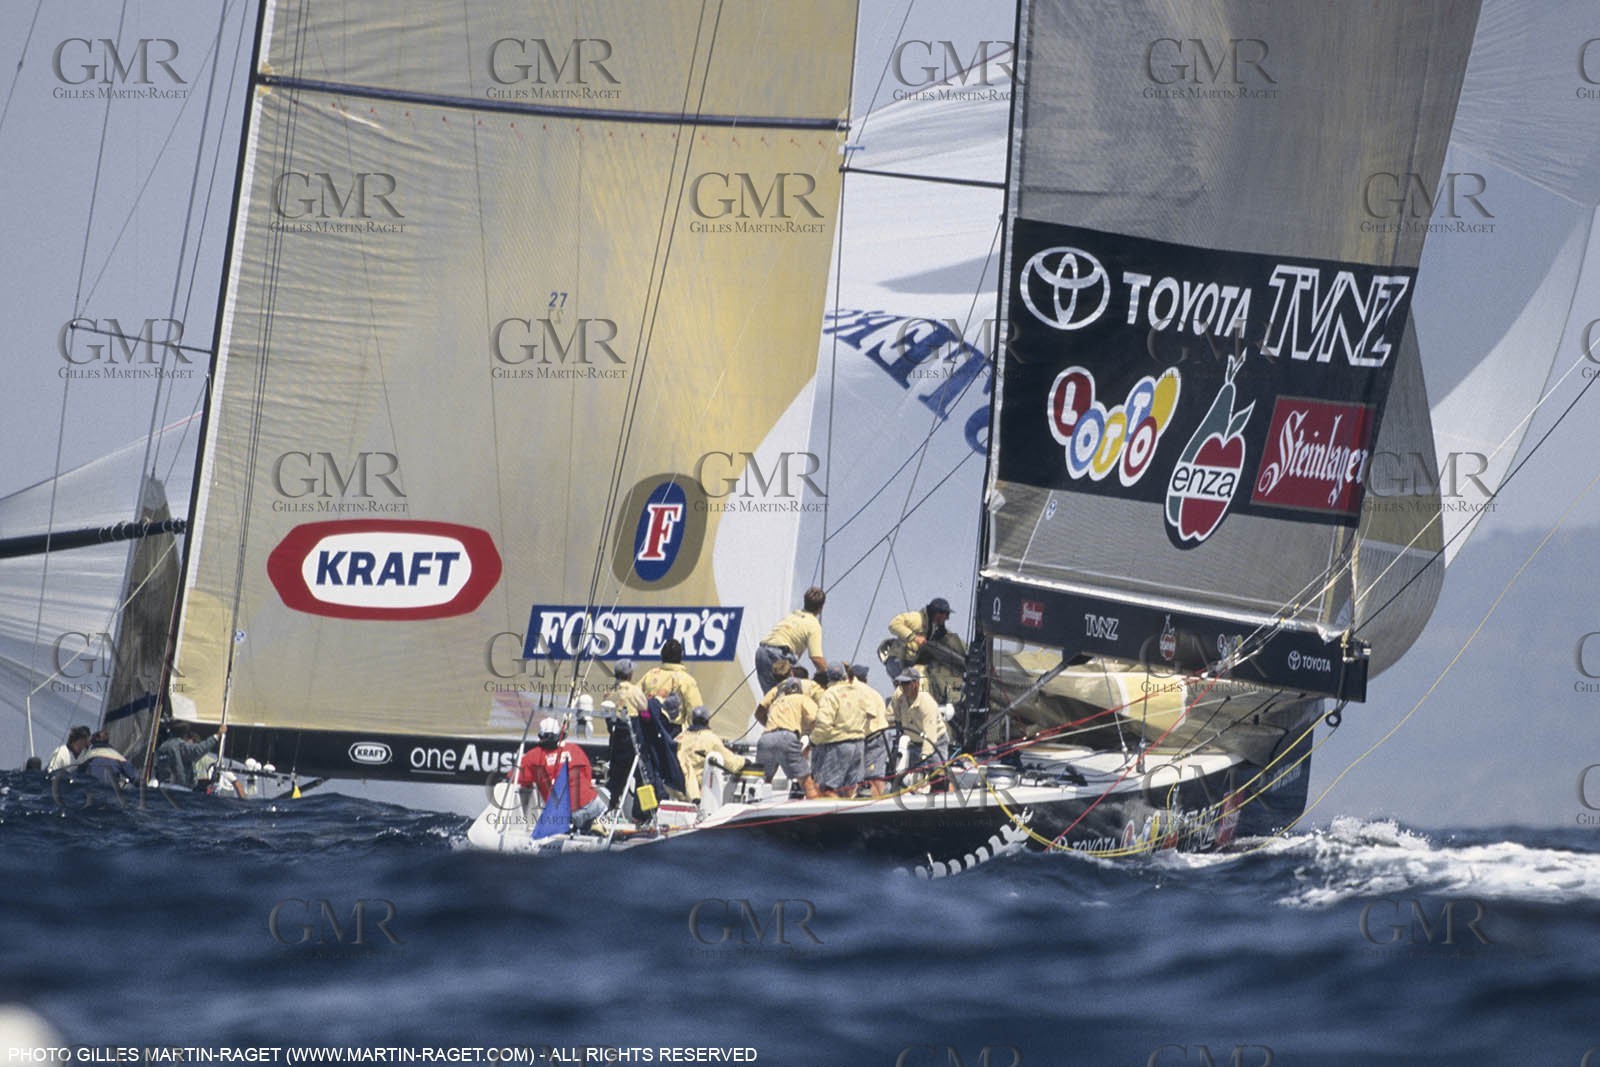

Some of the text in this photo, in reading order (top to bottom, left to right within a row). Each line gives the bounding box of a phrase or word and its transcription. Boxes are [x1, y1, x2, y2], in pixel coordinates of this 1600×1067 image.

[548, 291, 568, 308] 27
[1122, 271, 1252, 339] TOYOTA
[1260, 264, 1411, 368] TVNZ
[1056, 375, 1162, 477] LOTTO
[1257, 409, 1369, 507] Steinlager
[1171, 463, 1237, 499] enza
[638, 504, 684, 561] F
[315, 550, 461, 586] KRAFT
[533, 608, 732, 659] FOSTER'S
[1085, 613, 1119, 641] TVNZ
[1302, 655, 1332, 672] TOYOTA
[357, 748, 385, 760] KRAFT
[1072, 836, 1117, 852] TOYOTA
